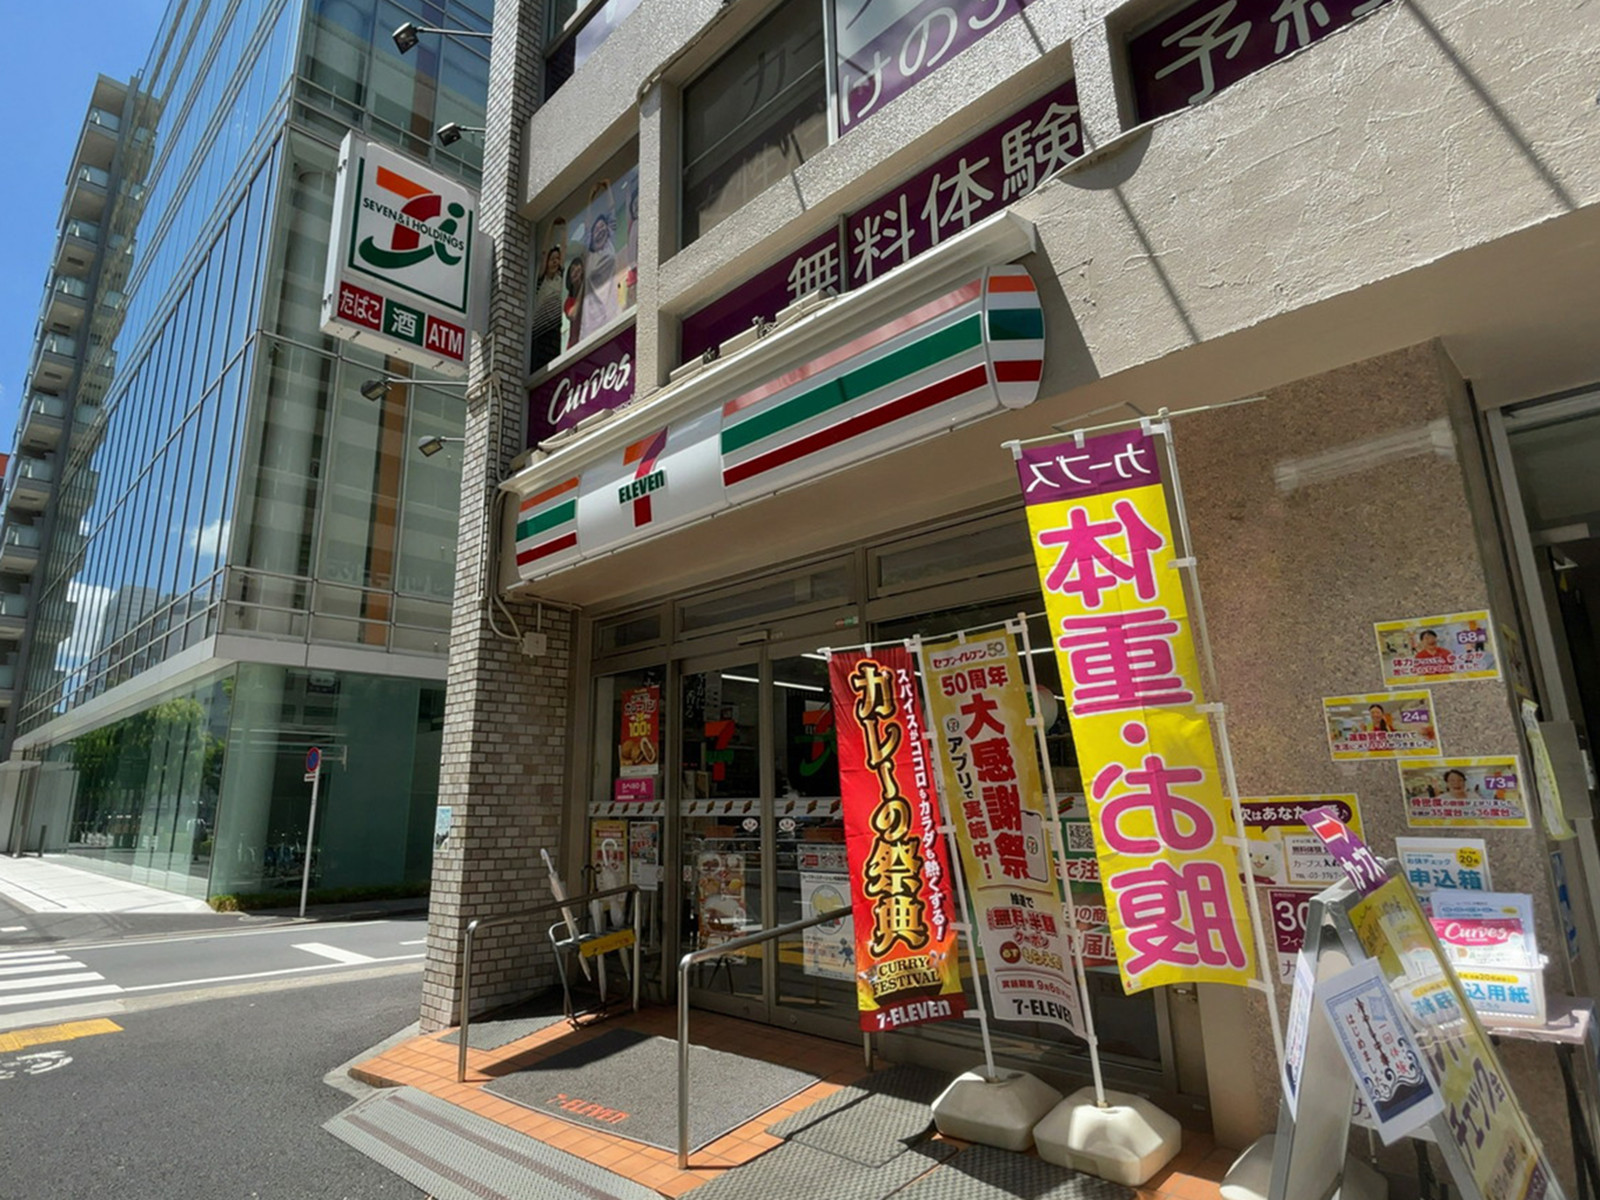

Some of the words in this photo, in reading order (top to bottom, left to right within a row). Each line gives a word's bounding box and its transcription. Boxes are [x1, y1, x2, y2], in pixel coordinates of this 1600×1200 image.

[787, 101, 1079, 303] 無料体験
[412, 219, 465, 252] HOLDINGS
[339, 288, 381, 324] たばこ
[391, 306, 418, 338] 酒
[428, 322, 463, 356] ATM
[548, 353, 631, 425] Curves
[941, 665, 1009, 697] 50周年
[960, 692, 1030, 880] 大感謝祭
[852, 662, 929, 957] カレーの祭典
[1409, 867, 1482, 891] 申込箱
[1444, 922, 1508, 940] Curves
[872, 970, 939, 996] FESTIVAL
[879, 957, 928, 977] CURRY
